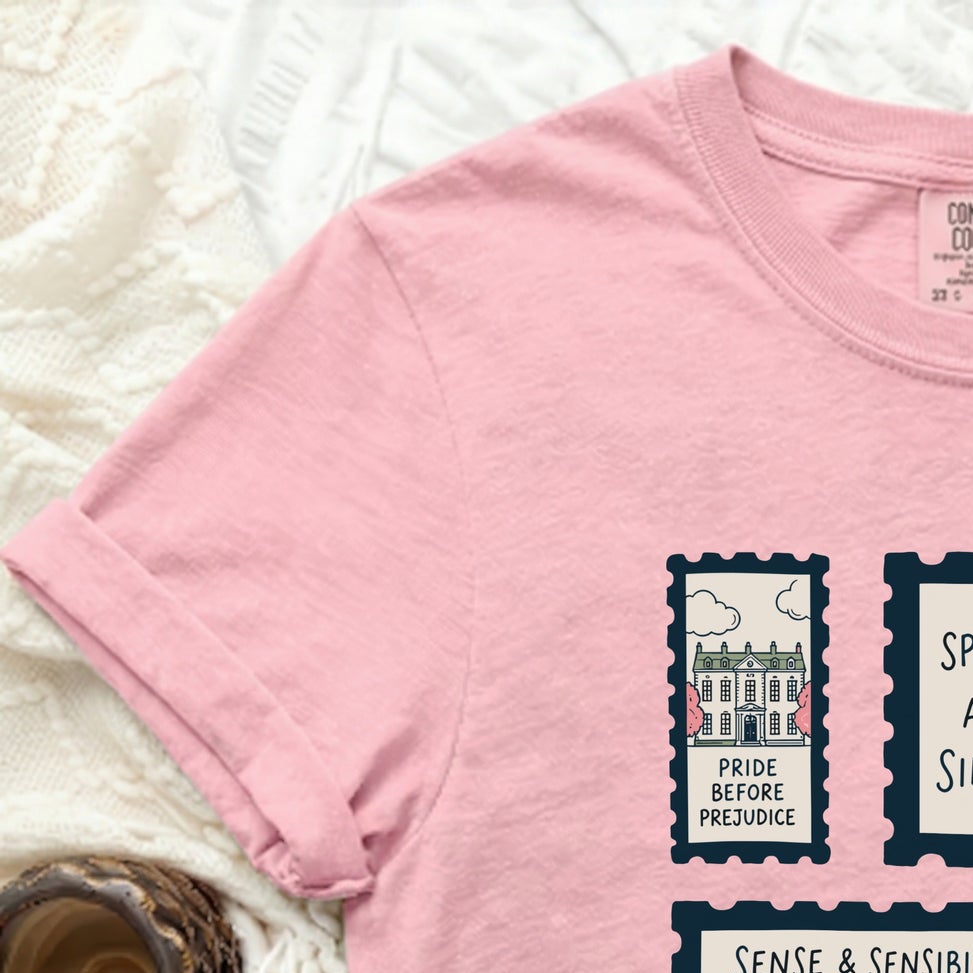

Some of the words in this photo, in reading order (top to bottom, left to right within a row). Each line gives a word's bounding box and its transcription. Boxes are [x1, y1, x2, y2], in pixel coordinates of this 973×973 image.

[720, 758, 776, 777] PRIDE
[713, 783, 783, 801] BEFORE
[701, 809, 795, 826] PREJUDICE
[839, 948, 855, 973] &
